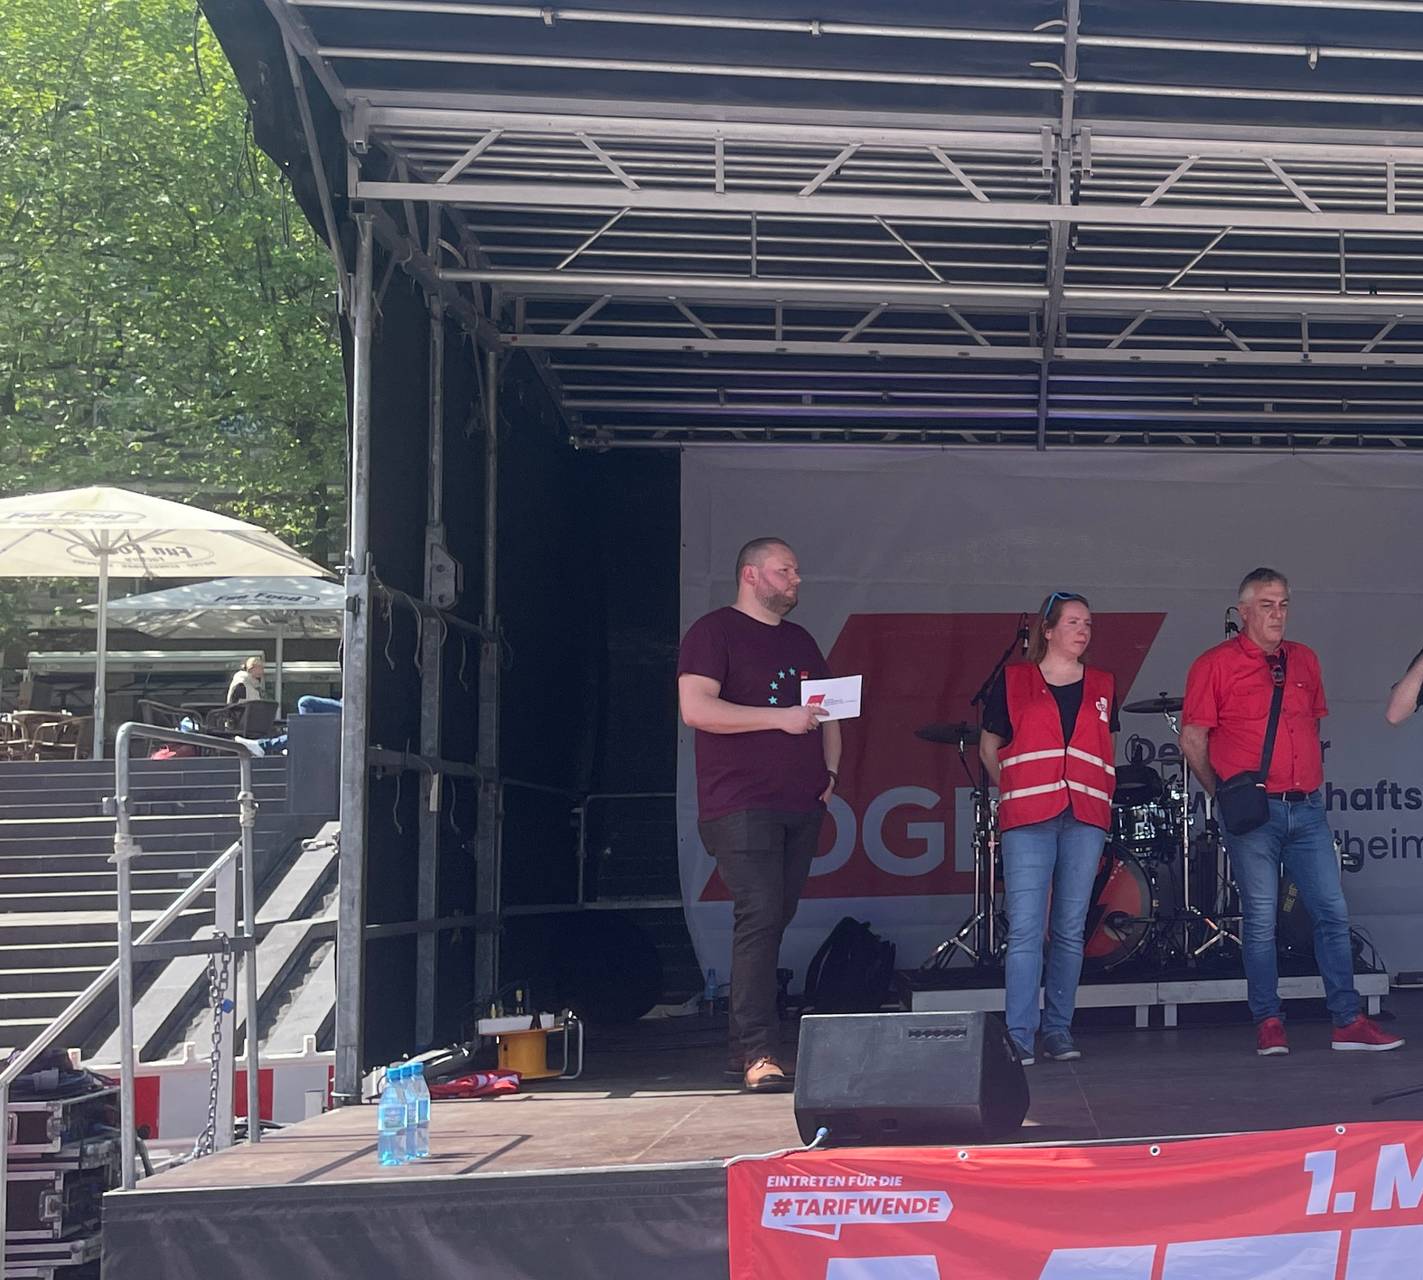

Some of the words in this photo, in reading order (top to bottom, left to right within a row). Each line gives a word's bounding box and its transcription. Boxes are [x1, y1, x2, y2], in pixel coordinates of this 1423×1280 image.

[766, 1176, 846, 1188] EINTRETEN
[848, 1173, 878, 1187] FÜR
[879, 1176, 903, 1187] DIE
[1304, 1150, 1356, 1215] 1.
[771, 1197, 941, 1217] #TARIFWENDE
